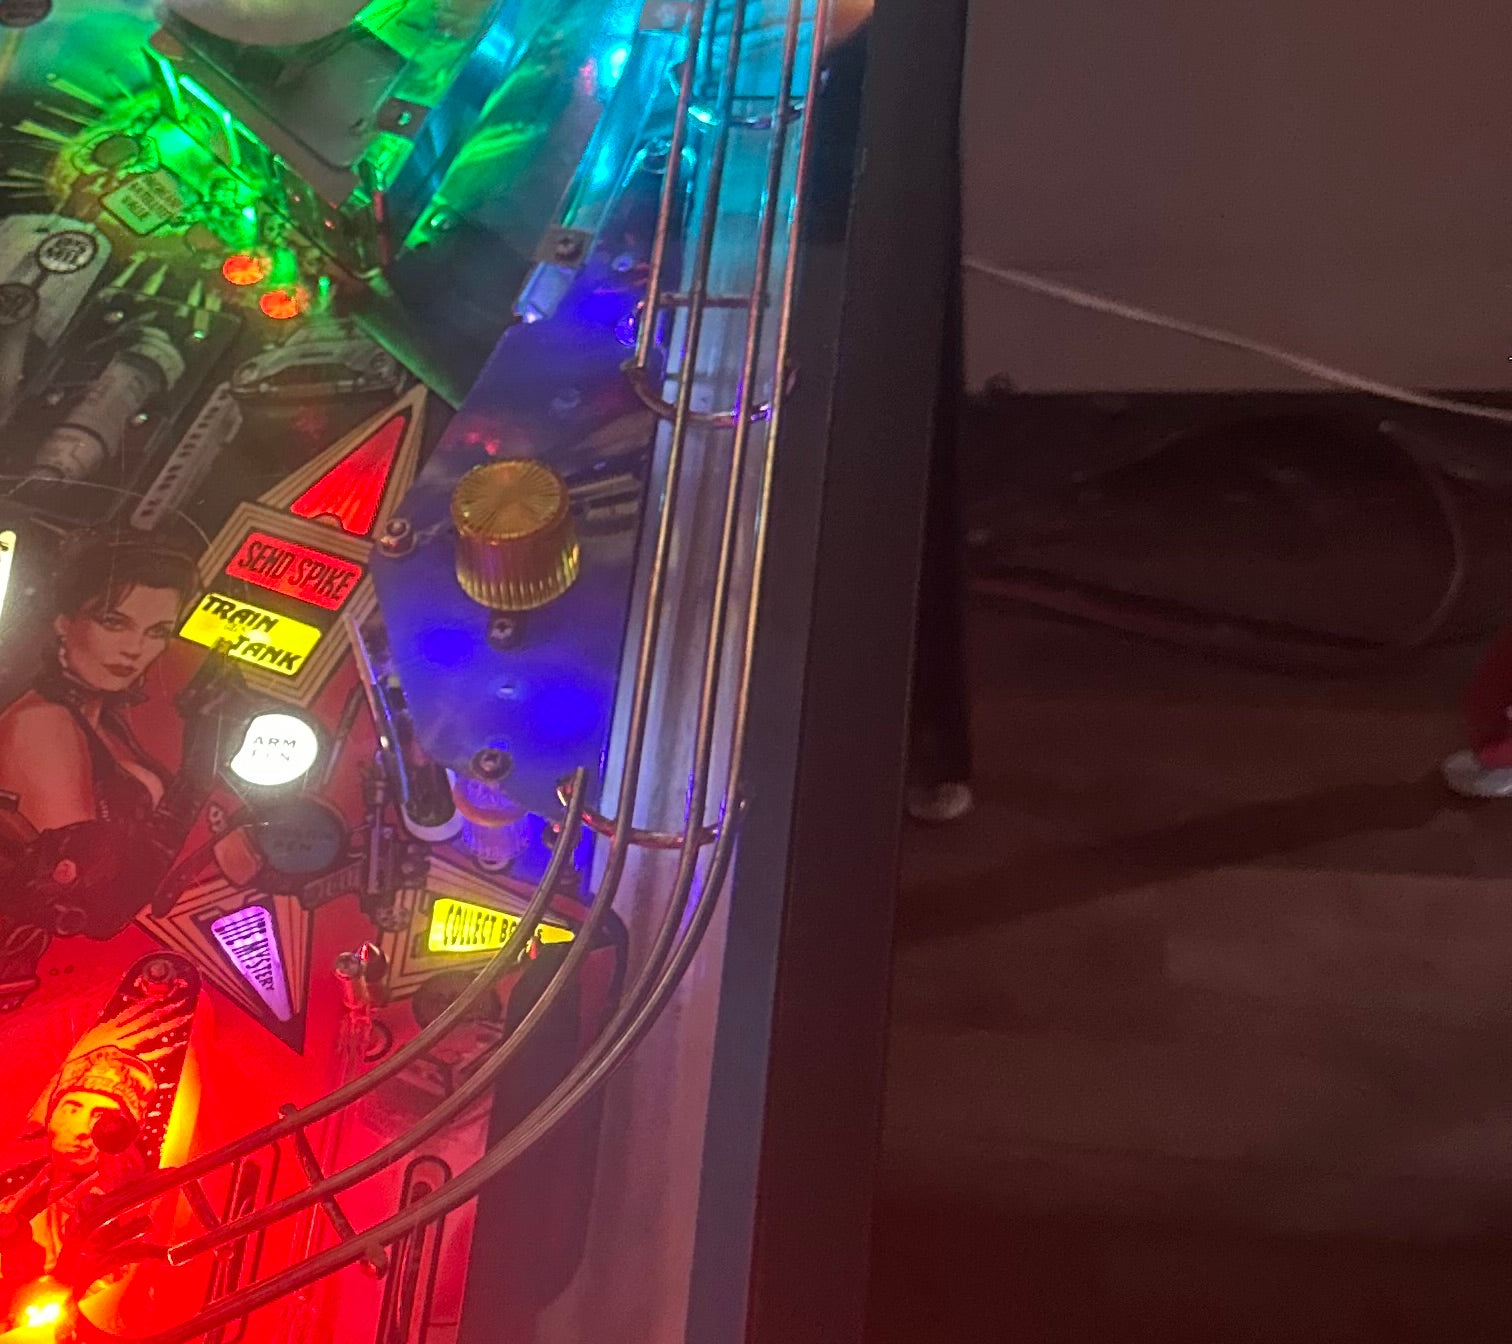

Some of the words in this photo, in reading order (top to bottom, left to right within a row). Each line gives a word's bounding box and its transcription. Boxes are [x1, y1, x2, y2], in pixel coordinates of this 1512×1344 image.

[239, 540, 295, 579] SEND
[289, 560, 355, 602] SPIKE
[200, 594, 279, 634] TRAIN
[229, 634, 304, 672] TANK
[444, 903, 498, 946] COLLECT
[232, 936, 276, 993] MYSTERY
